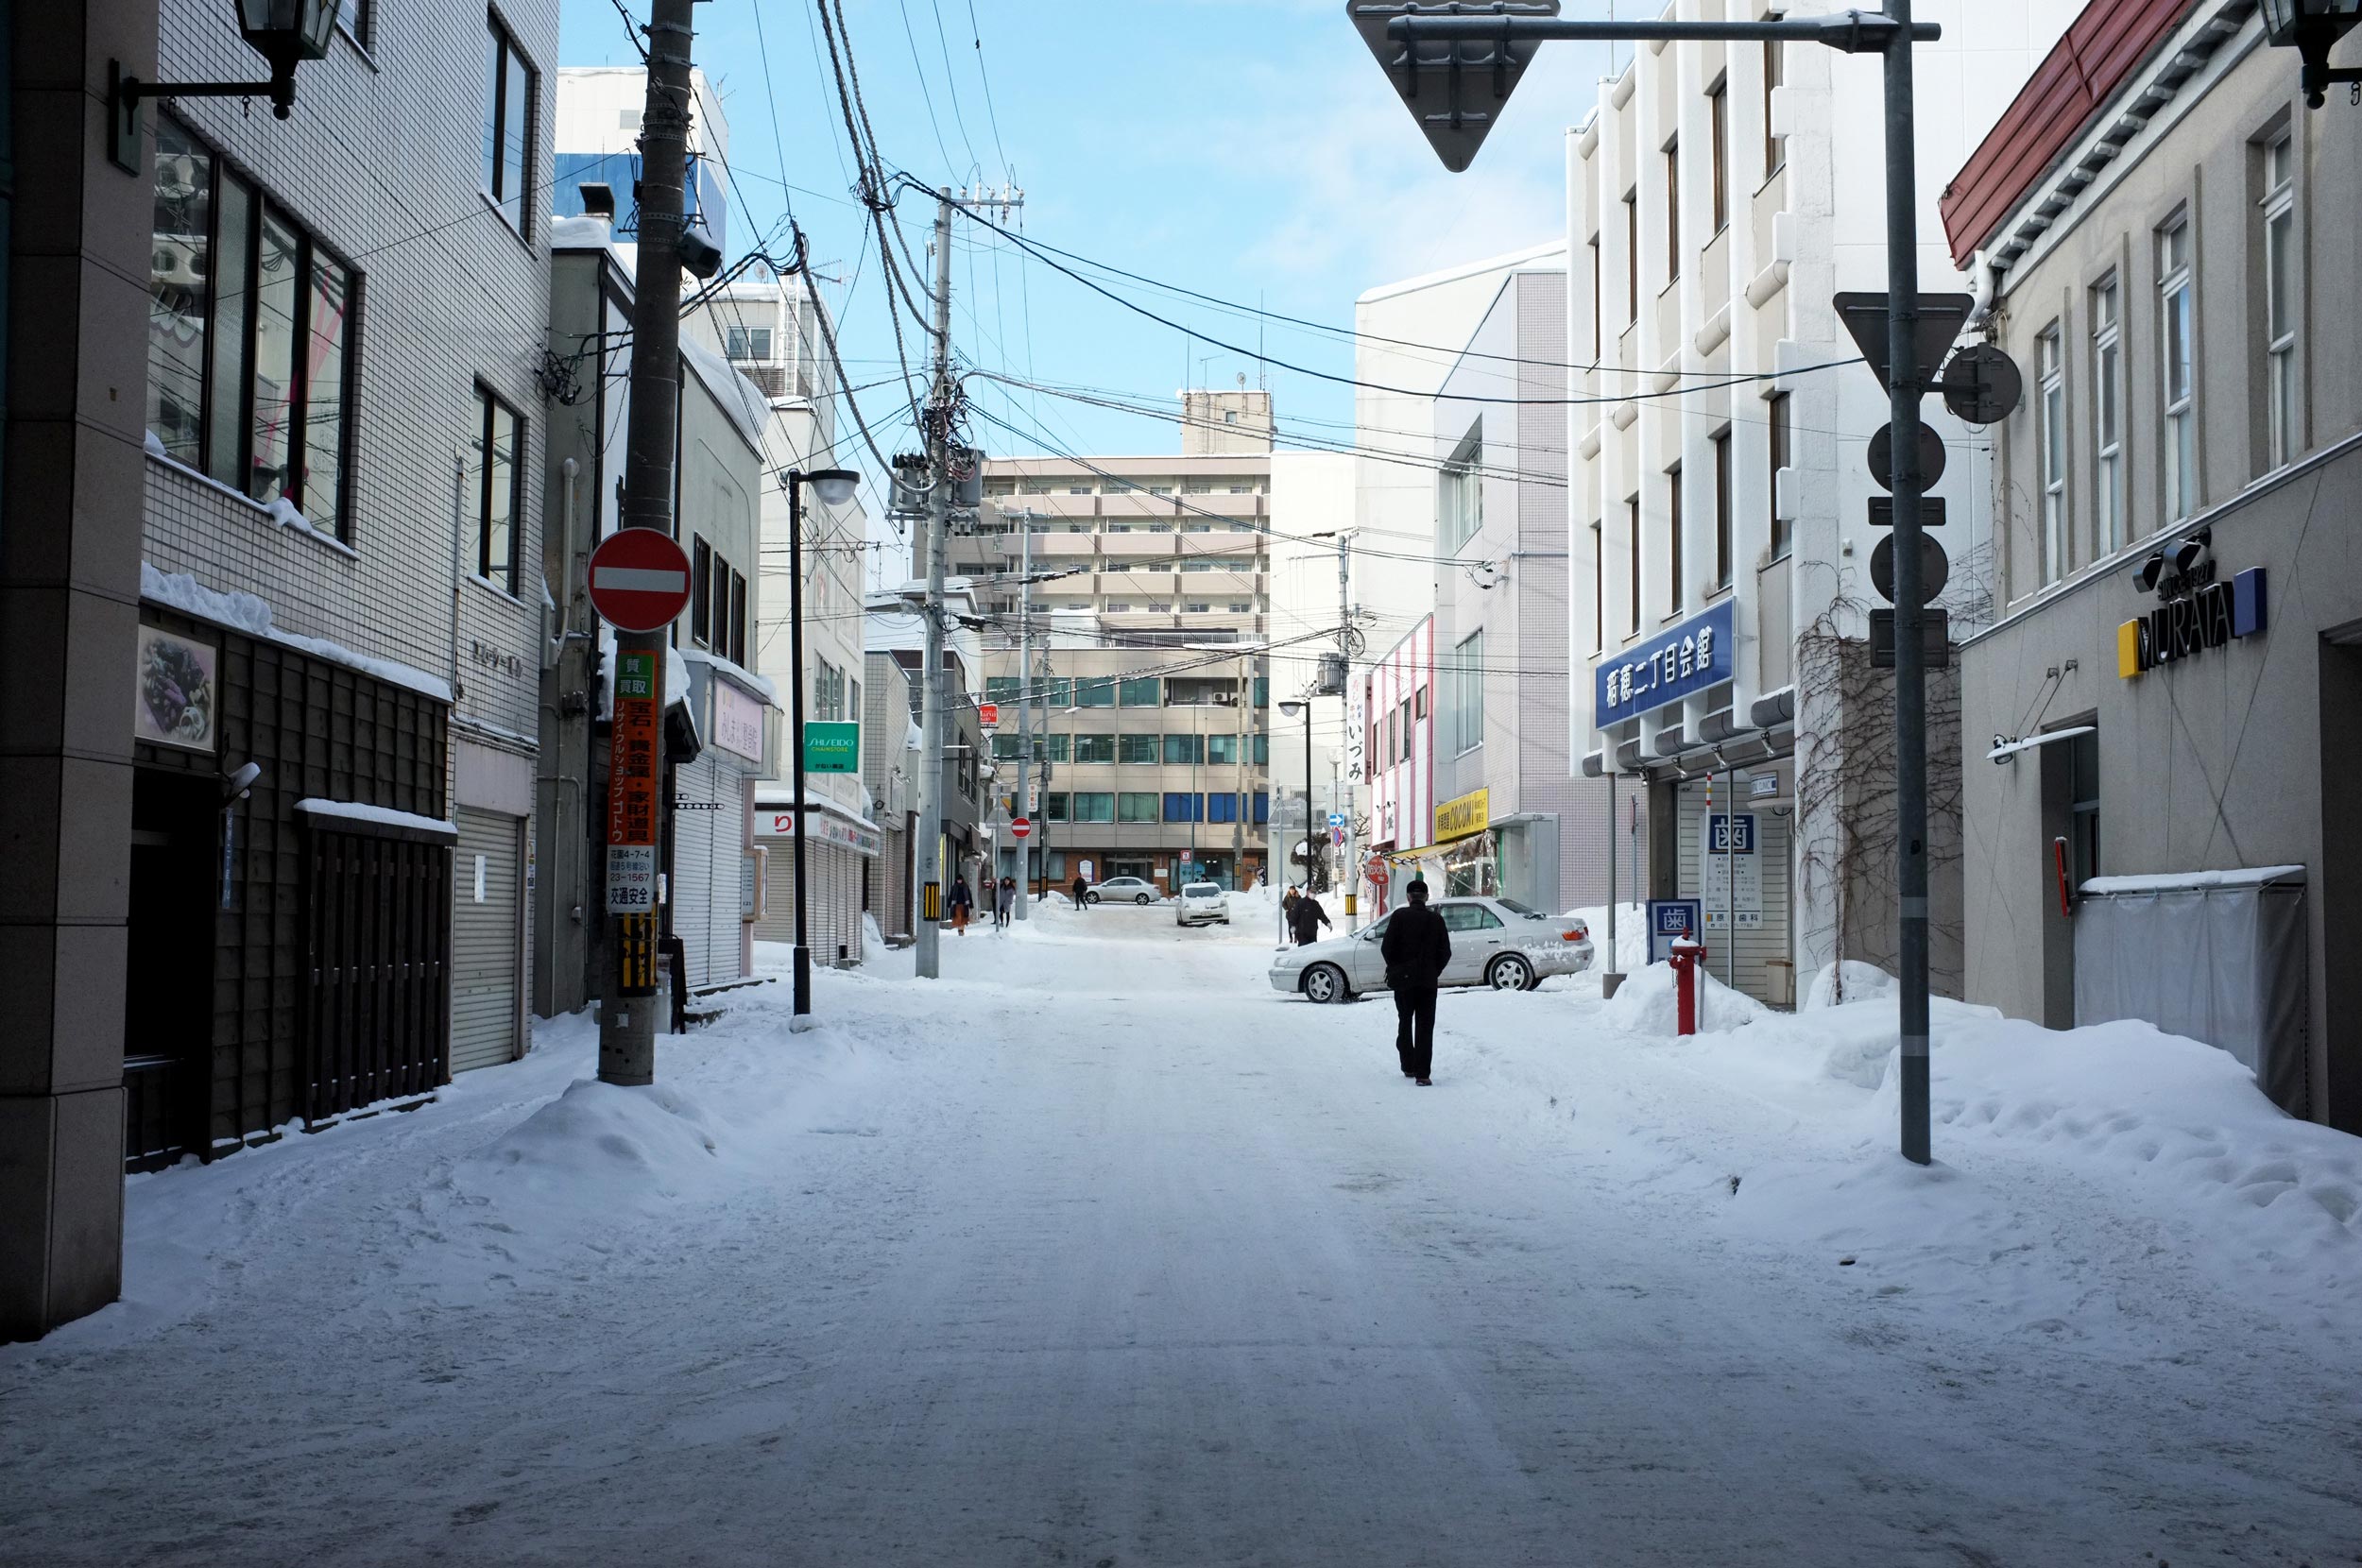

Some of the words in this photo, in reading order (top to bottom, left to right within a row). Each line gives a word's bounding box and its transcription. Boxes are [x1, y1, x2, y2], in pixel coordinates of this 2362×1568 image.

[2137, 583, 2237, 672] MURATA
[625, 657, 640, 673] 質
[1606, 624, 1713, 709] 稲穂二丁目会館
[620, 679, 646, 694] 買取
[807, 738, 854, 747] SHISEIDO
[1348, 724, 1363, 781] いづみ
[775, 815, 793, 832] り
[1714, 817, 1748, 850] 歯
[609, 873, 650, 882] 23-1567
[610, 886, 648, 905] 交通安全
[1662, 908, 1687, 930] 歯
[1717, 913, 1758, 922] 原歯科
